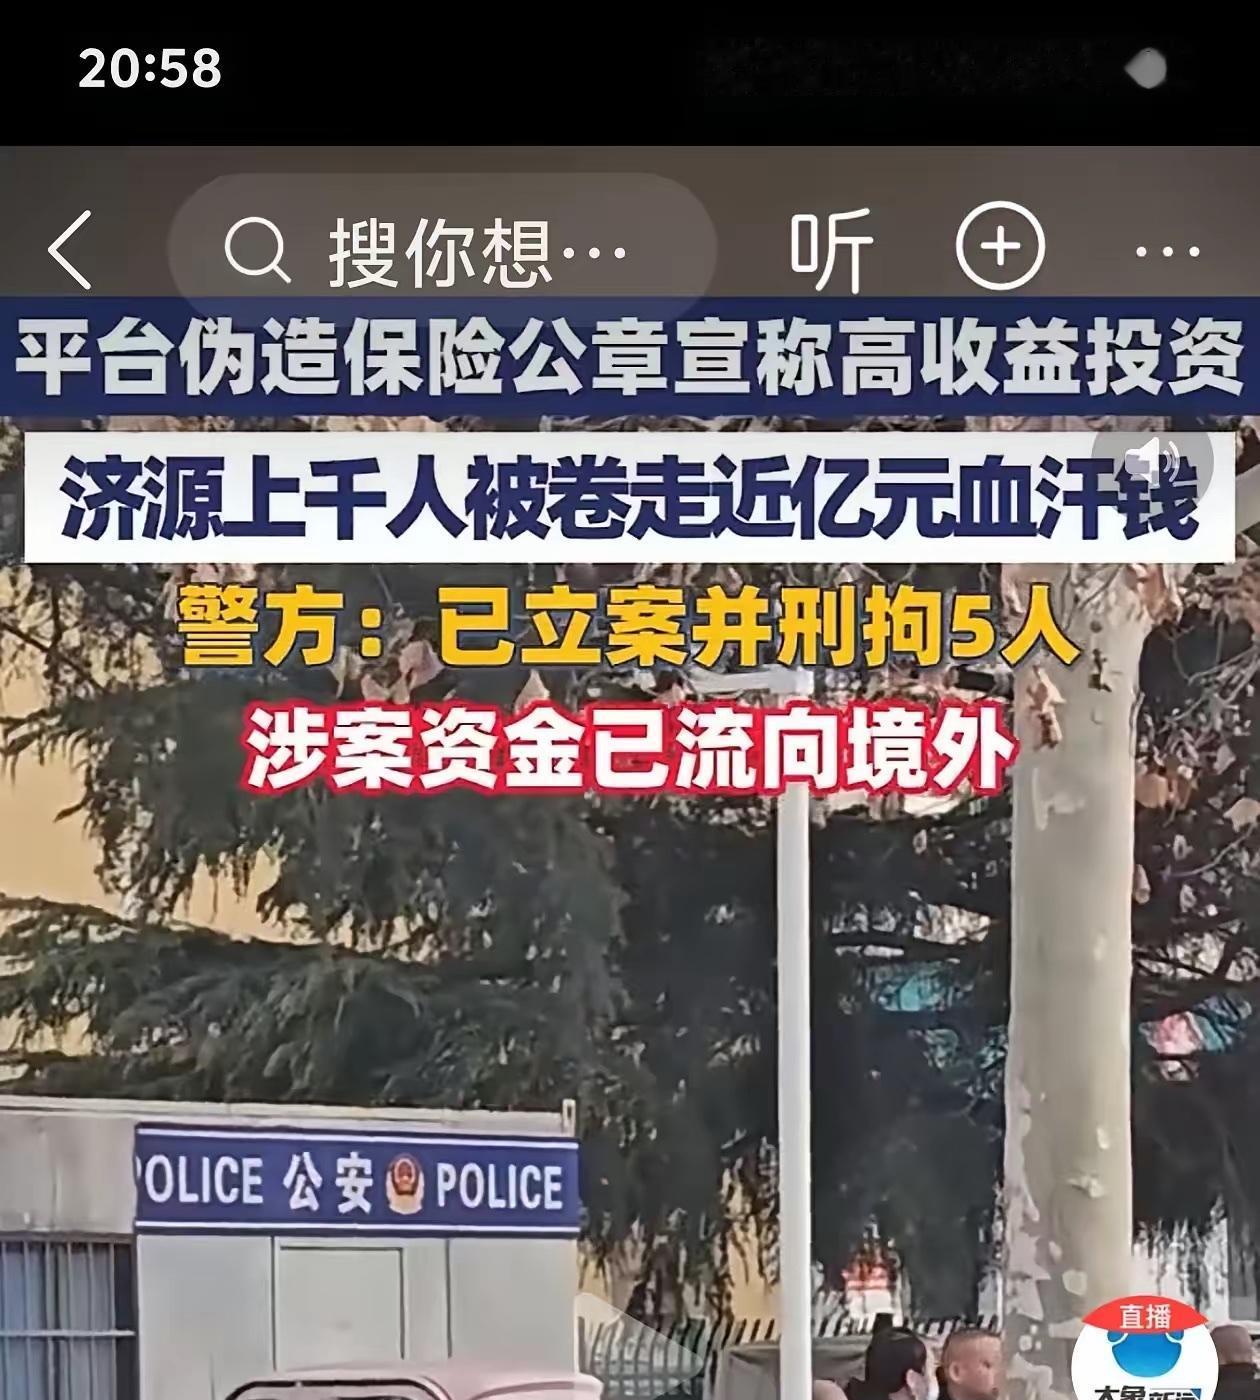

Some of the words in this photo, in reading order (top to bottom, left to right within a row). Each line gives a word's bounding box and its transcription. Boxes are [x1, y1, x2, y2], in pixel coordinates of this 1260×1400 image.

[136, 1154, 264, 1204] OLICE
[283, 1151, 373, 1214] 公安
[437, 1162, 563, 1210] POLICE
